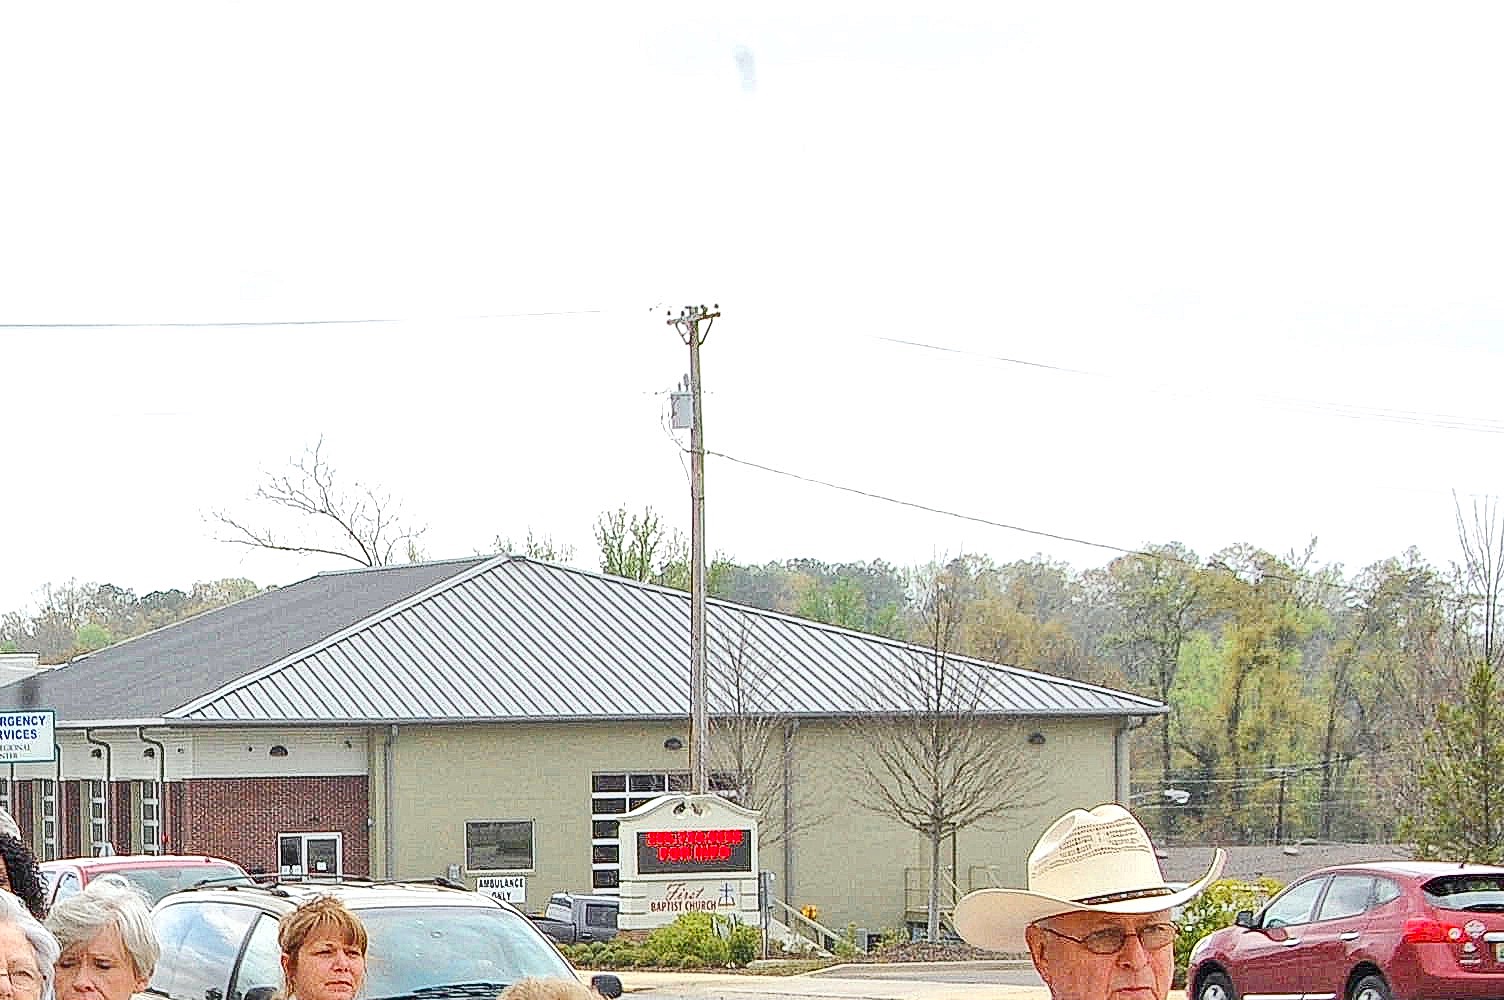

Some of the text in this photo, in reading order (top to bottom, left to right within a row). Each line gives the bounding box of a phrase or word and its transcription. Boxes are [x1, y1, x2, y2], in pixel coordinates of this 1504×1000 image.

[479, 878, 523, 888] AMBULANCE
[666, 882, 705, 899] First
[651, 900, 716, 912] BAPTIST CHURCH
